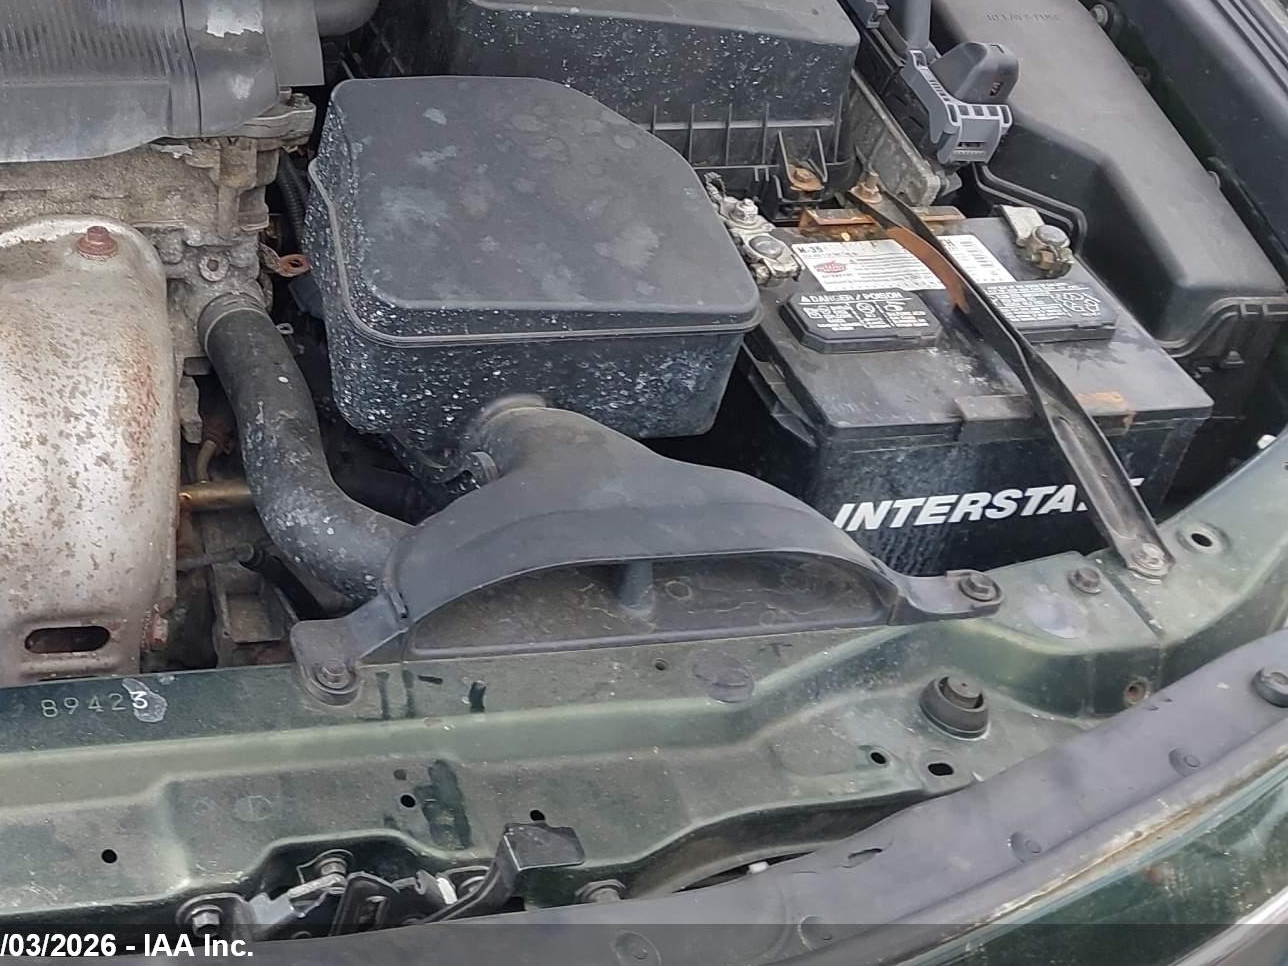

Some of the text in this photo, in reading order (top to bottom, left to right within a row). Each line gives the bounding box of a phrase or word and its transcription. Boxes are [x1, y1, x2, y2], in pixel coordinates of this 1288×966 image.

[810, 293, 855, 303] DANGER
[862, 291, 903, 300] POISON
[833, 477, 1145, 532] INTERSTA
[40, 690, 149, 718] 89423
